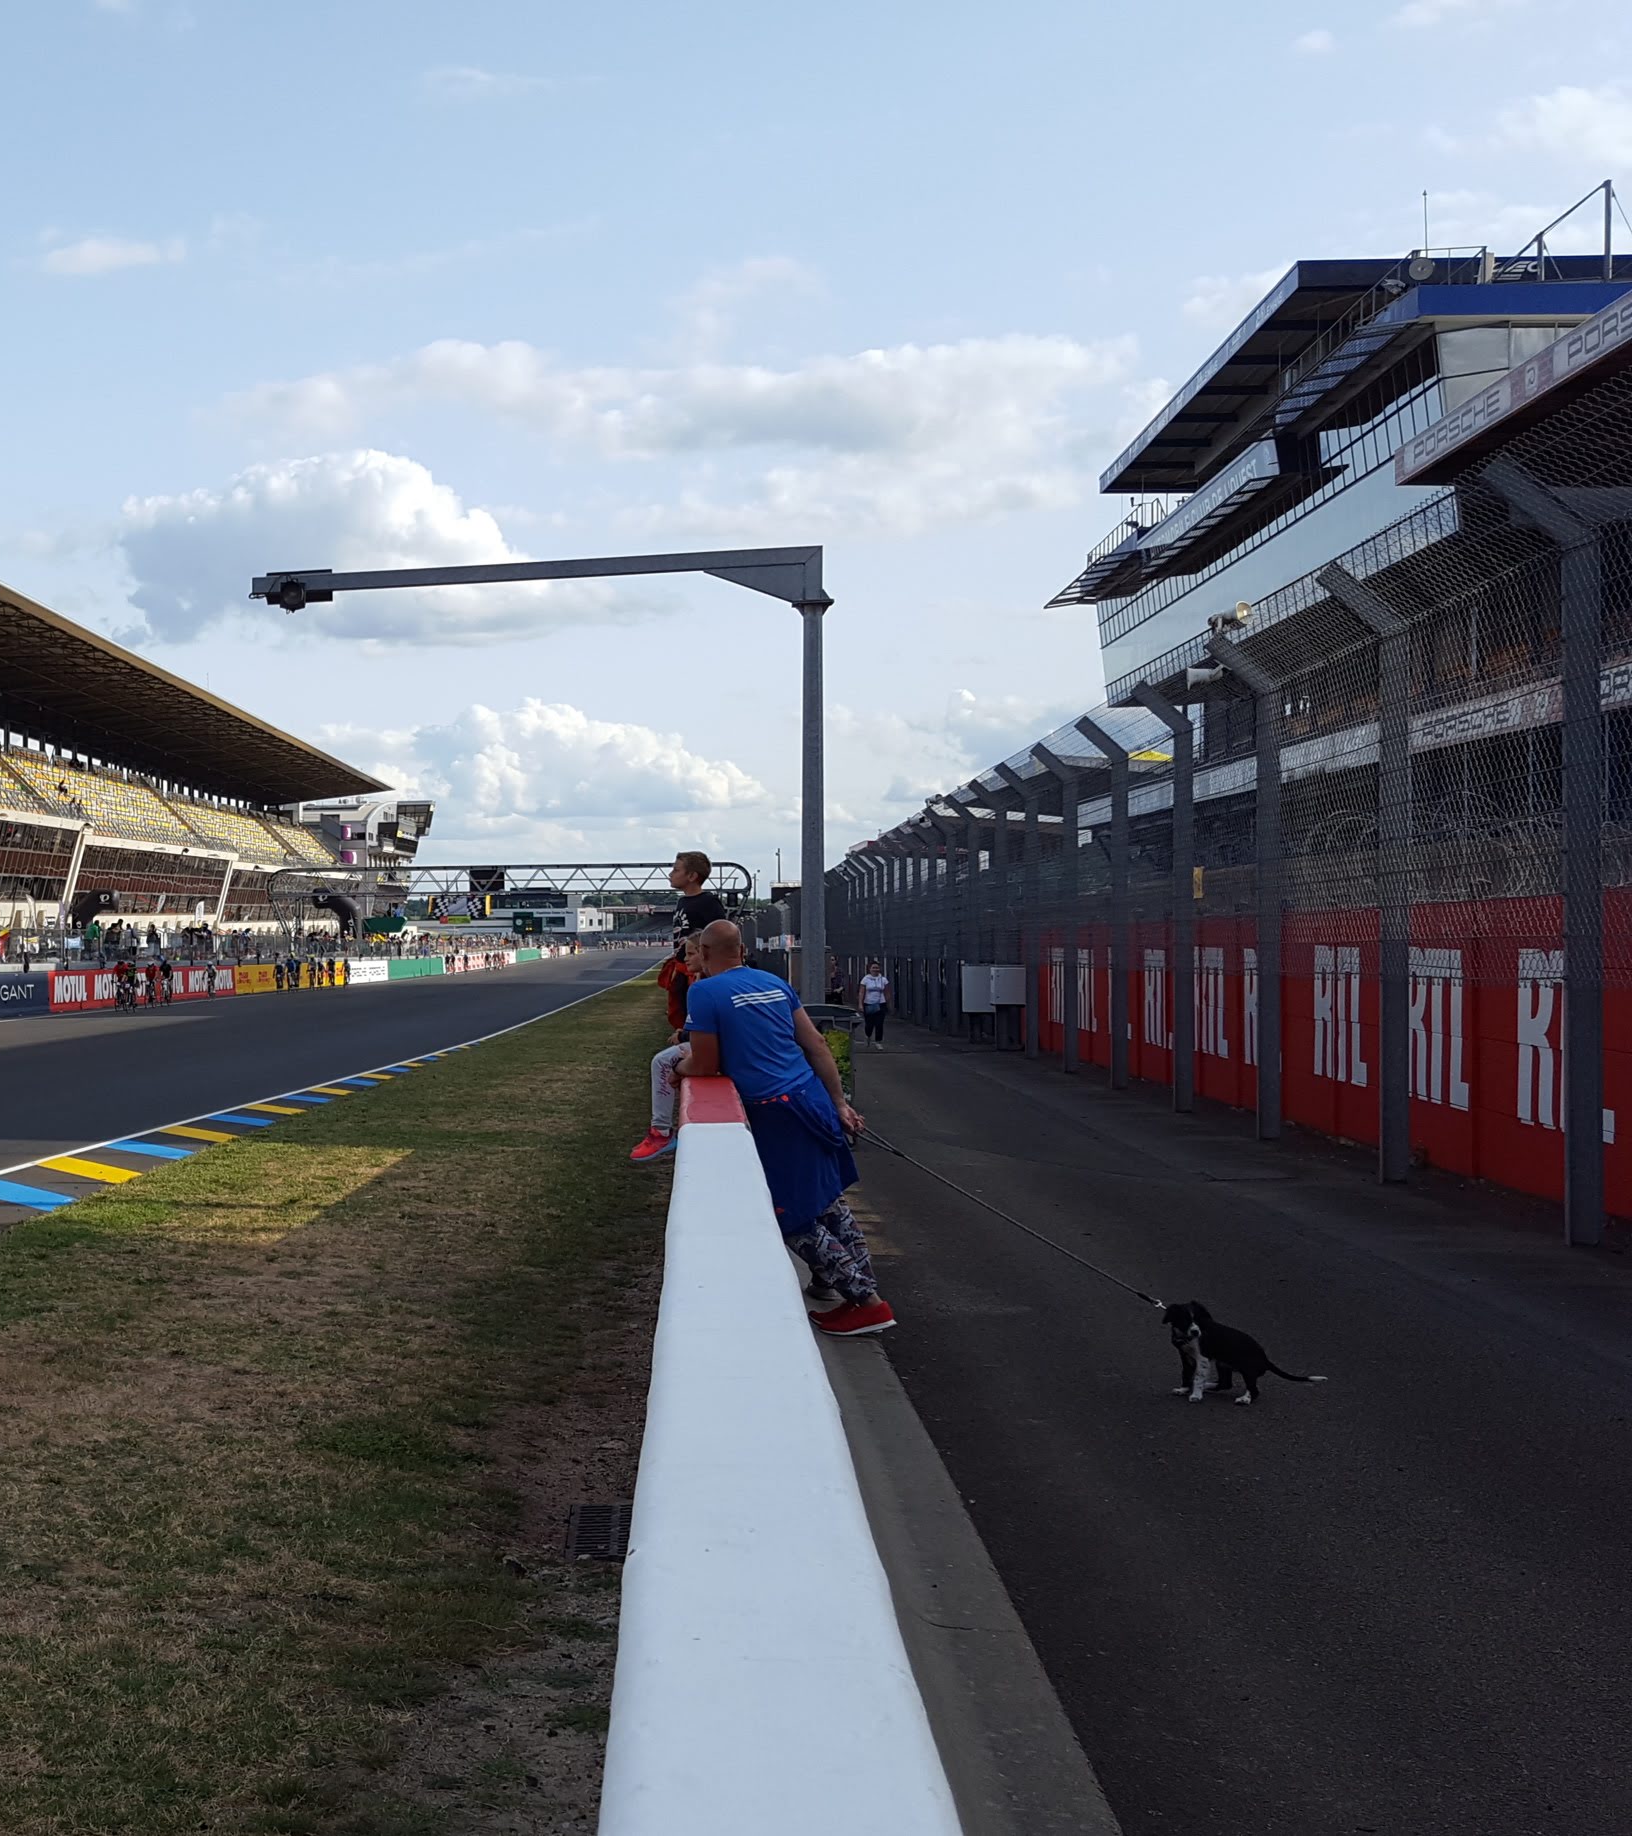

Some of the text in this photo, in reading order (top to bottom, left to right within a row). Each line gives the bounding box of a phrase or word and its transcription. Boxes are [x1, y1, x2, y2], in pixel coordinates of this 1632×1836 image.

[1413, 389, 1501, 465] PORSCHE
[0, 984, 35, 1001] GANT
[54, 975, 87, 1004] MOTUL
[1313, 945, 1367, 1087] RTL
[1408, 946, 1469, 1111] RTL
